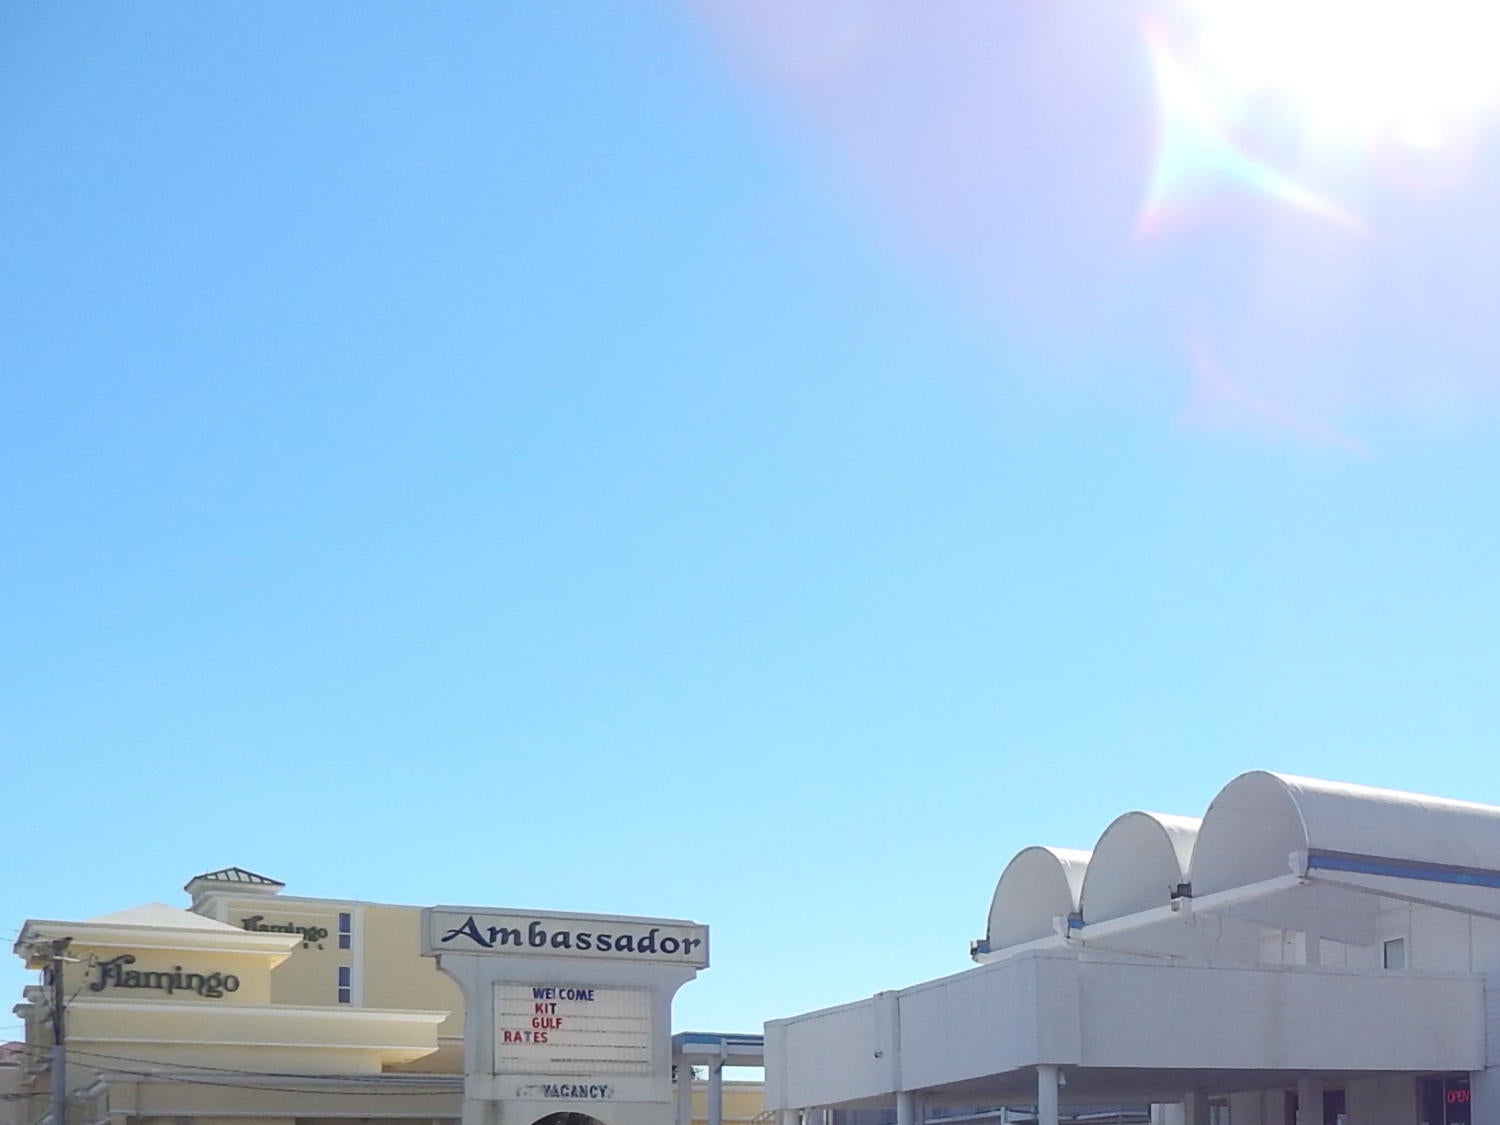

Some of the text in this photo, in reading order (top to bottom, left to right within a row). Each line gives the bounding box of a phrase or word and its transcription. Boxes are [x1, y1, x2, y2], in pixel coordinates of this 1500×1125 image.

[241, 915, 328, 942] Flamingo
[441, 916, 701, 956] Ambassador
[90, 954, 240, 998] Flamingo
[535, 1003, 557, 1015] KIT
[532, 1017, 563, 1030] GULF
[503, 1032, 549, 1044] RATES
[542, 1084, 608, 1099] VACANCY
[1447, 1090, 1470, 1103] OPEN
